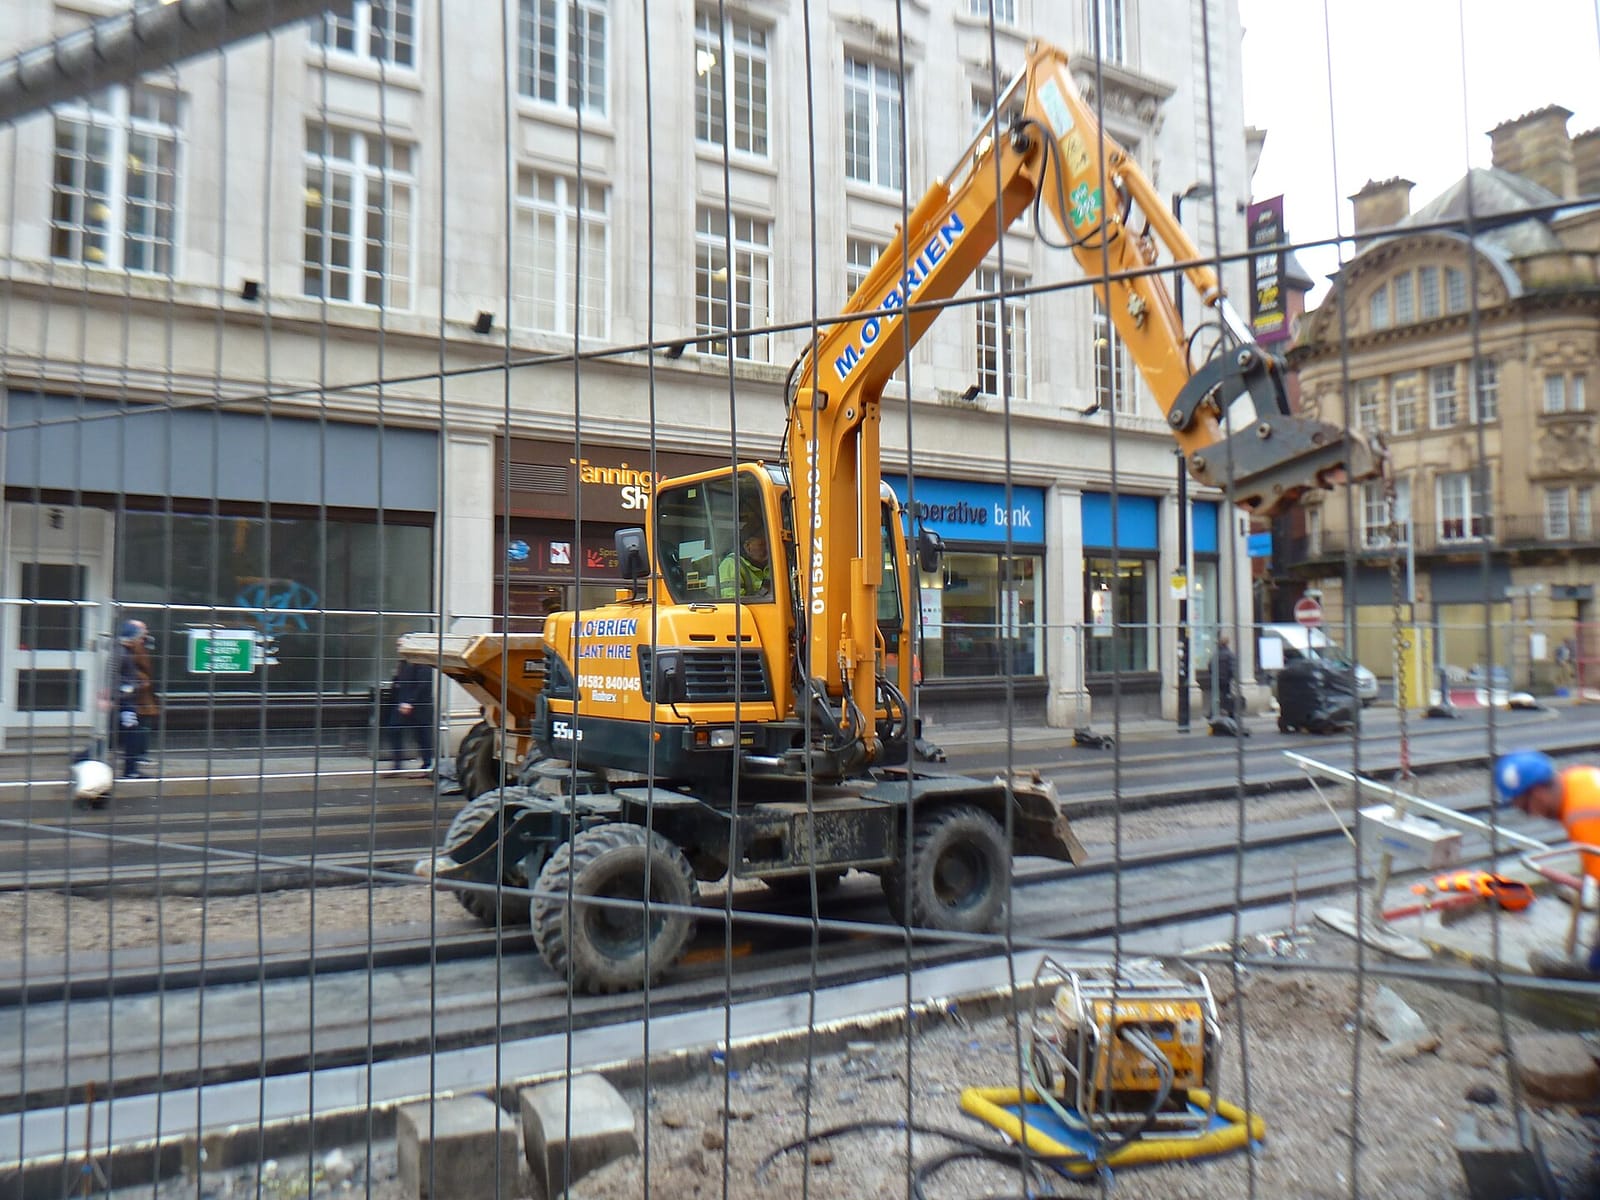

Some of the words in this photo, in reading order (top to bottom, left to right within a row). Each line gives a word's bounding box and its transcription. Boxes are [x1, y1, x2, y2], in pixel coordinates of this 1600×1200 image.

[569, 457, 653, 494] Tanning
[621, 485, 649, 510] Sh
[994, 502, 1032, 527] bank
[811, 537, 825, 615] 01582
[577, 644, 604, 659] LANT
[605, 644, 632, 659] HIRE
[577, 675, 604, 689] 01582
[605, 676, 641, 691] 840045
